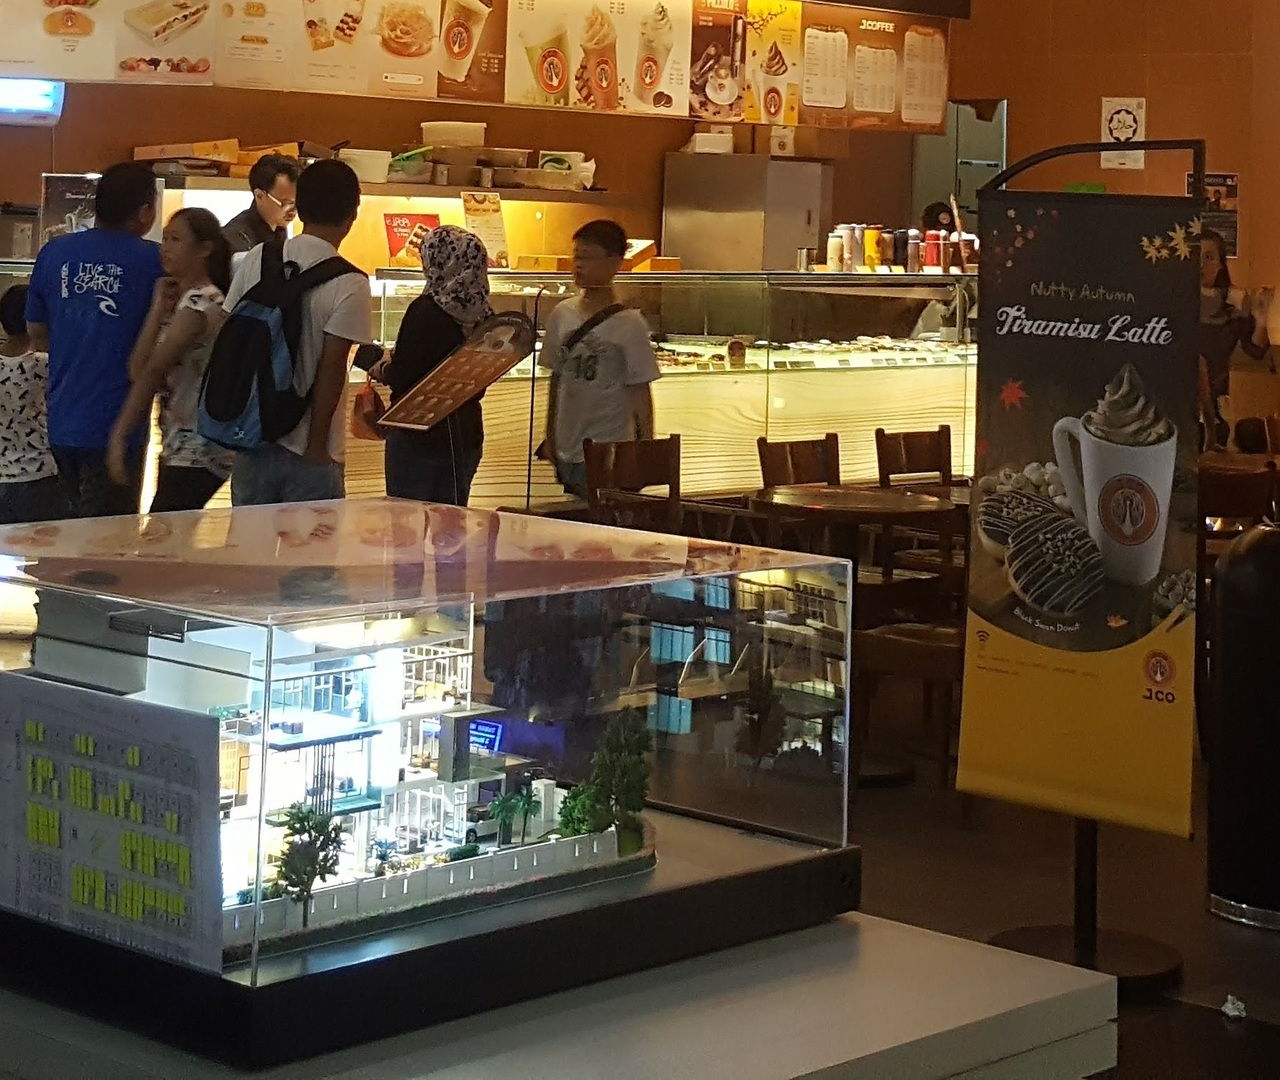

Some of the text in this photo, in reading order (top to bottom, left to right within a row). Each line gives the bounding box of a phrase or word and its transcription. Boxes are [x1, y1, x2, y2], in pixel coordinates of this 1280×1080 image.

[79, 262, 124, 277] LIVE THE
[73, 274, 124, 294] SEARCH
[1030, 281, 1136, 304] Nutty Autumn
[995, 303, 1173, 345] Tiramisu Latte
